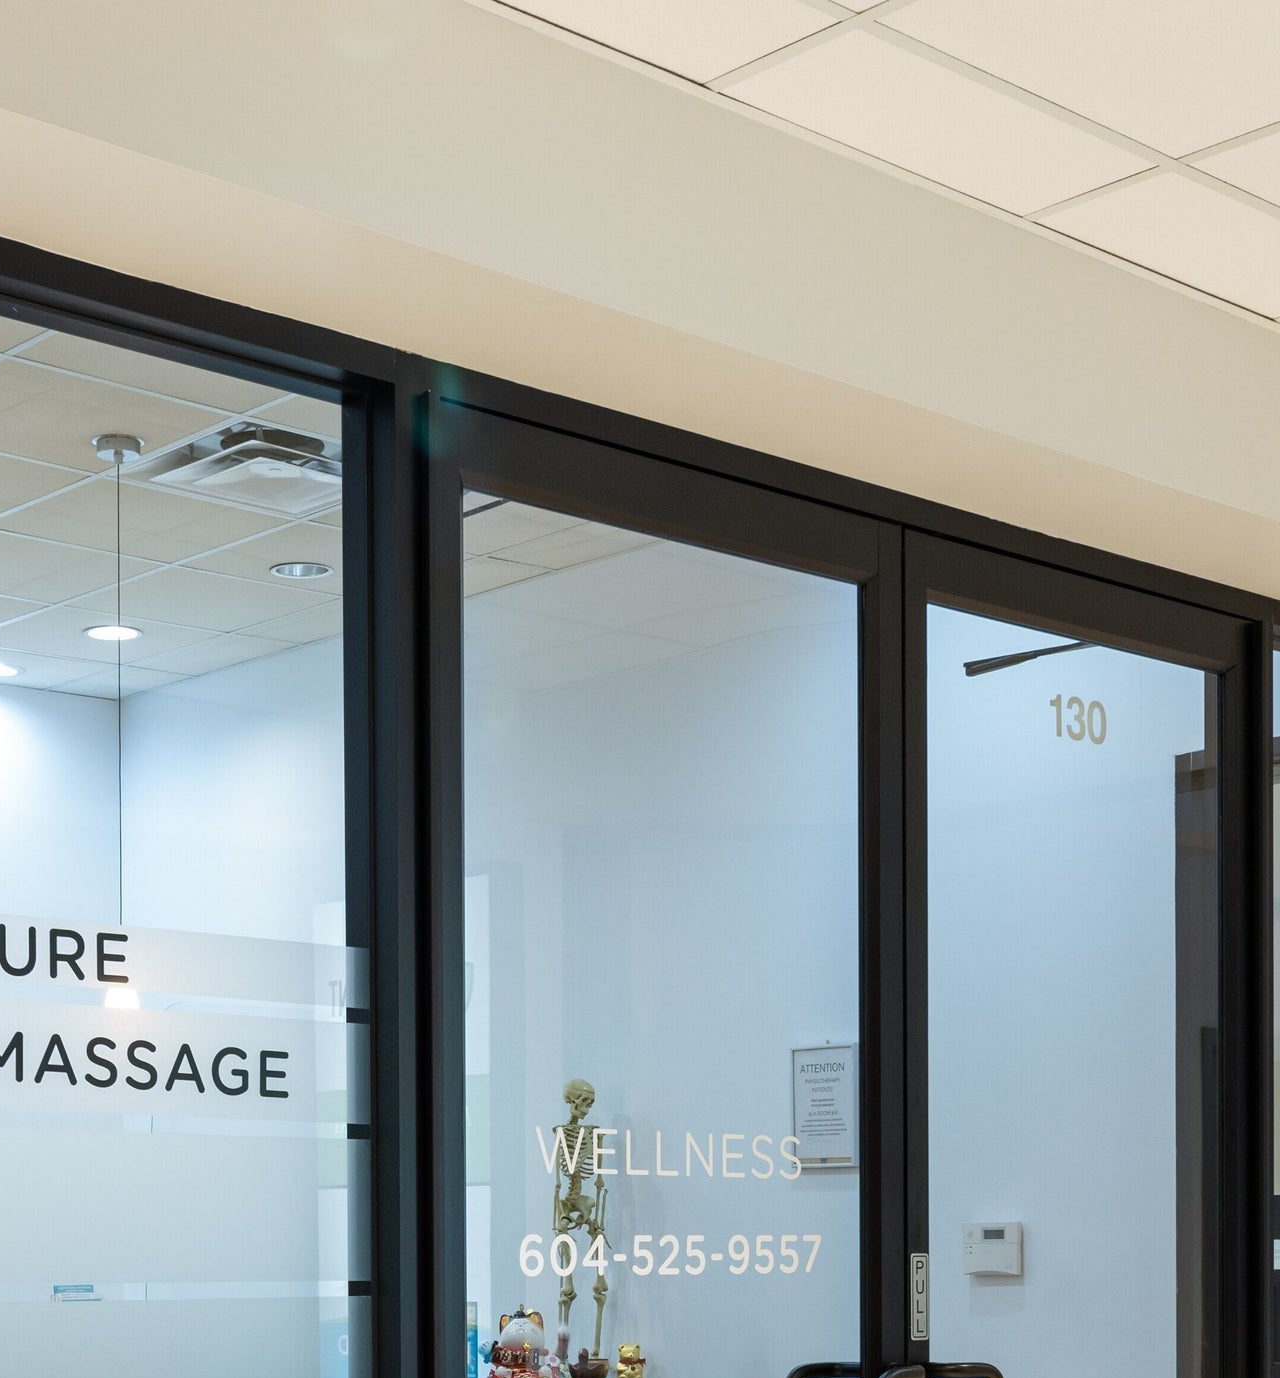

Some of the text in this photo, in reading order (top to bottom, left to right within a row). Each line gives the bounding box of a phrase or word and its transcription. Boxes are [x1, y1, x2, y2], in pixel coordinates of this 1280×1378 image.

[1049, 694, 1107, 745] 130
[800, 1062, 845, 1075] ATTENTION
[536, 1126, 802, 1180] WELLNESS
[519, 1233, 822, 1278] 604-525-9557
[915, 1260, 925, 1333] PULL
